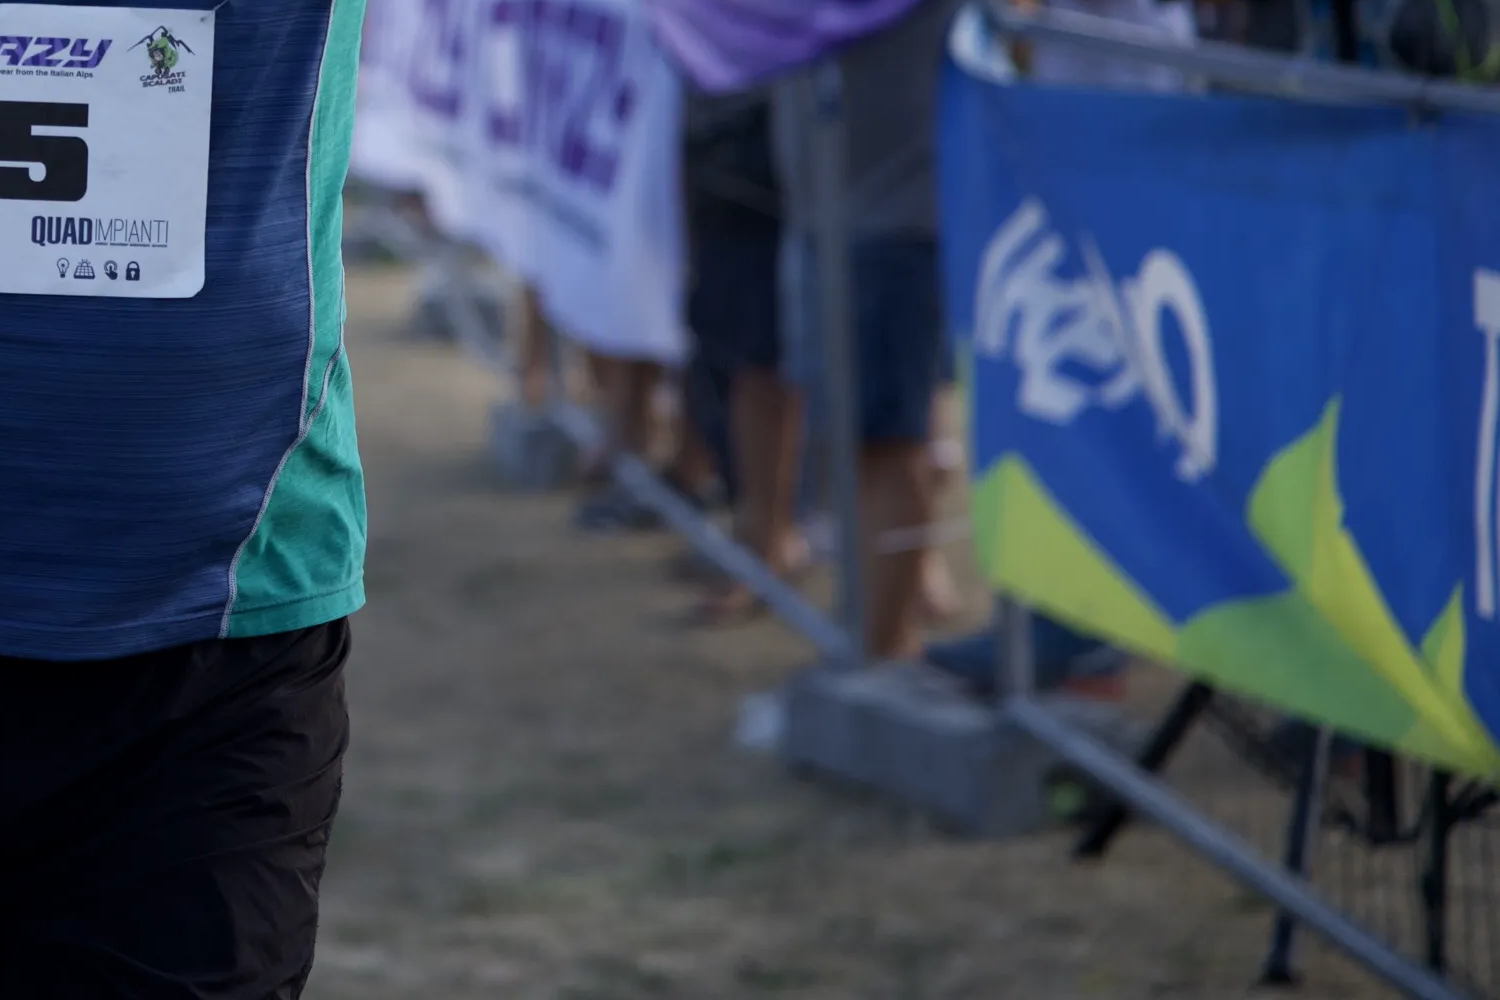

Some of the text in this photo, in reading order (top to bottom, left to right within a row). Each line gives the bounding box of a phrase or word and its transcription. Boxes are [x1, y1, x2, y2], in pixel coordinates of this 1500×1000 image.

[15, 68, 34, 76] from
[35, 69, 49, 77] the
[50, 70, 74, 78] Italian
[76, 71, 94, 79] Alps
[168, 84, 186, 93] TRAIL
